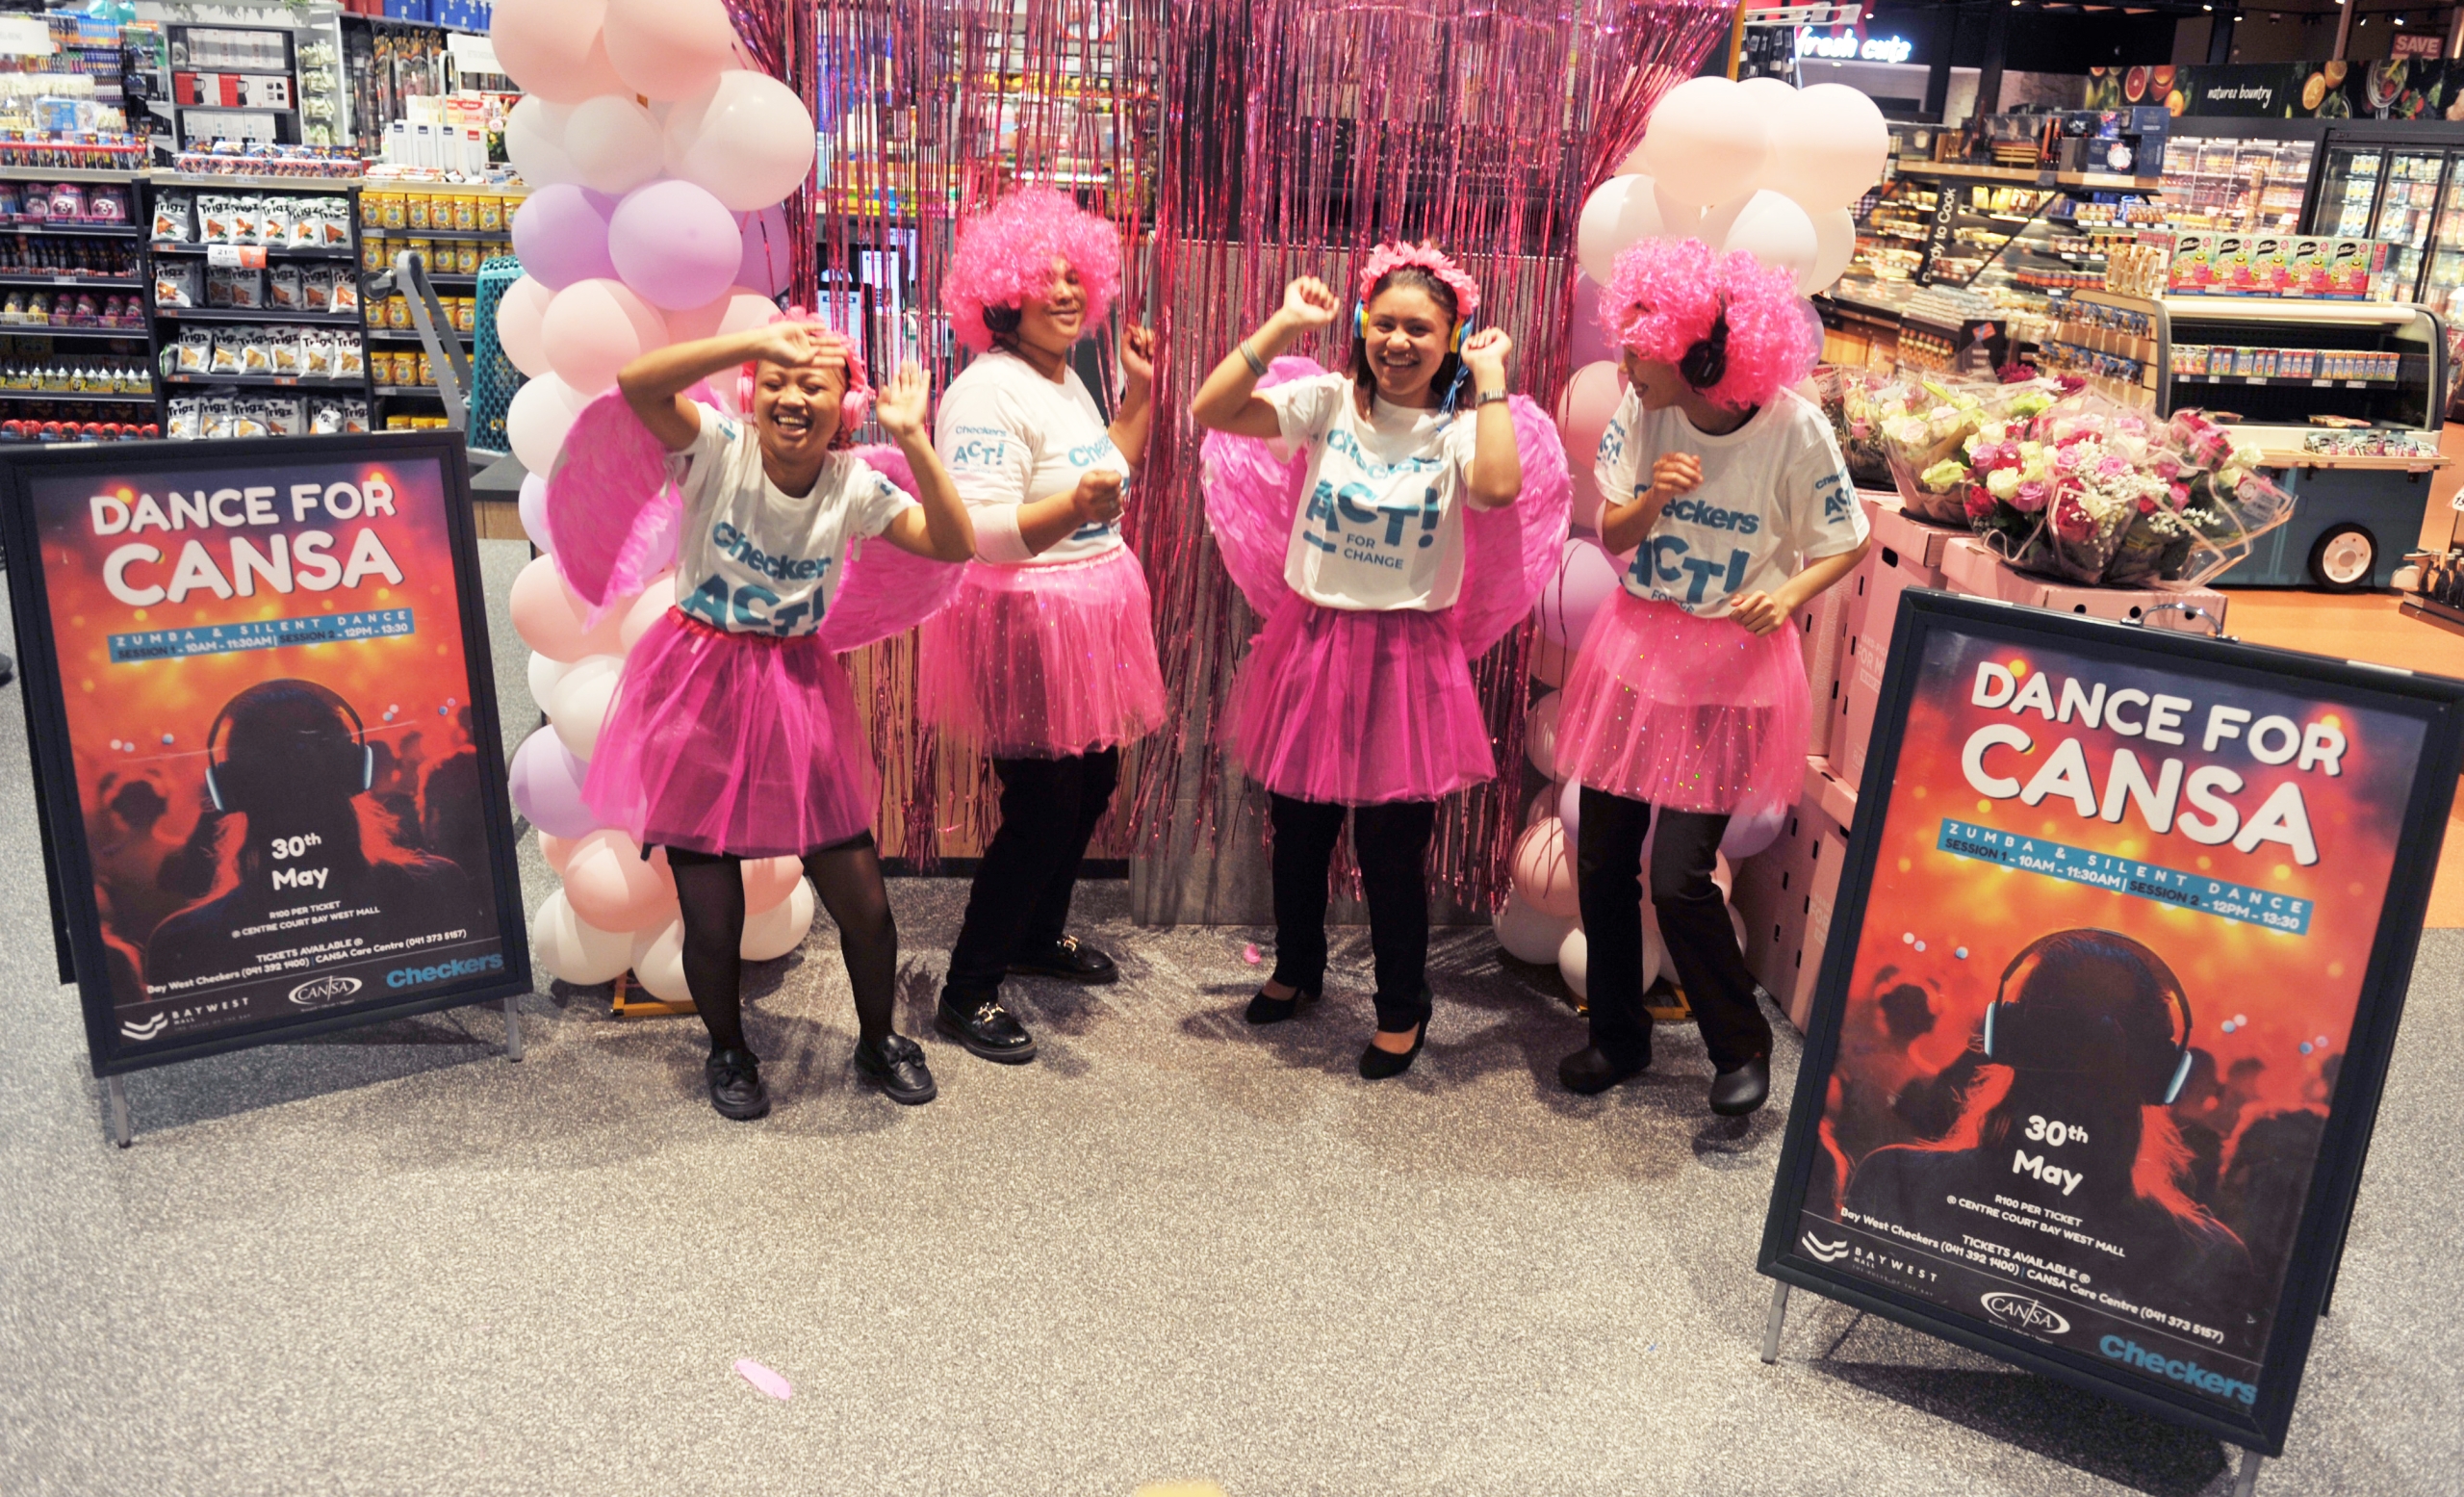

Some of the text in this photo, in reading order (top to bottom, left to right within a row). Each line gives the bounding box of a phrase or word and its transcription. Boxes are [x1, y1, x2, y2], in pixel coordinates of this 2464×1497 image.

[1861, 35, 1912, 64] cuts
[2396, 35, 2440, 53] SAVE
[199, 202, 230, 214] Trigz
[1937, 188, 1957, 223] Cook
[1934, 225, 1947, 240] to
[156, 268, 186, 278] rigz
[179, 332, 208, 344] Trigz
[270, 333, 300, 346] Trigz
[167, 404, 194, 416] Trigz
[199, 402, 227, 414] Trigz
[234, 404, 264, 414] Trigz
[266, 406, 293, 418] Trigz
[953, 441, 1005, 466] ACT!
[90, 479, 398, 535] DANCE FOR
[1305, 478, 1440, 549] ACT!
[1633, 484, 1759, 534] Ceckers
[712, 522, 832, 581] Checker
[1347, 533, 1375, 549] FOR
[102, 528, 404, 607] CANSA
[1344, 547, 1404, 570] CHANGE
[680, 574, 826, 637] ACT!
[116, 610, 406, 647] ZUMBA & SILENT DANCE
[117, 647, 167, 659] SESSION
[185, 641, 218, 654] 10AM
[227, 635, 271, 649] 11:30AM
[279, 632, 326, 644] SESSION
[327, 631, 335, 639] 2
[345, 626, 372, 637] 12PM
[382, 623, 408, 633] 13:30
[1971, 661, 2347, 776] DANCE FOR
[1962, 723, 2320, 865] CANSA
[270, 832, 321, 861] 30th
[271, 866, 329, 890] May
[1945, 838, 1998, 860] SESSION
[2001, 851, 2008, 861] 1
[2018, 855, 2055, 872] 10AM
[2066, 865, 2121, 888] 11:30AM
[2129, 880, 2187, 903] SESSION
[2191, 894, 2199, 906] 2
[2212, 899, 2250, 918] 12PM
[2262, 911, 2300, 930] 13:30
[1949, 822, 2302, 914] ZUMBA & SILENT DANCE
[231, 906, 380, 939] @ CENTRE COURT BAY WEST MALL
[270, 900, 341, 920] R100 PER TICKET
[146, 985, 167, 994] Bay
[168, 979, 194, 992] West
[196, 971, 241, 986] Checkers
[241, 967, 263, 979] (041
[264, 963, 282, 974] 392
[284, 957, 310, 969] 1400)
[315, 951, 348, 964] CANSA
[350, 946, 372, 957] Care
[373, 941, 404, 953] Centre
[405, 938, 424, 949] (041
[425, 934, 443, 943] 373
[256, 938, 364, 963] TICKETS AVAILABLE @
[386, 951, 503, 990] Checkers
[2025, 1115, 2089, 1148] 30th
[2013, 1149, 2084, 1196] May
[1946, 1195, 2125, 1257] @ CENTRE COURT BAY WEST MALL
[1994, 1194, 2083, 1226] R100 PER TICKET
[1840, 1206, 2224, 1344] Bay West Checkers (041 392 1400) CANSA Care Centre (041 373 5157)
[1854, 1257, 1875, 1269] MALL
[1962, 1234, 2091, 1284] TICKETS AVAILABLE @
[1990, 1298, 2053, 1329] CANSA
[2099, 1334, 2259, 1406] Checkers
